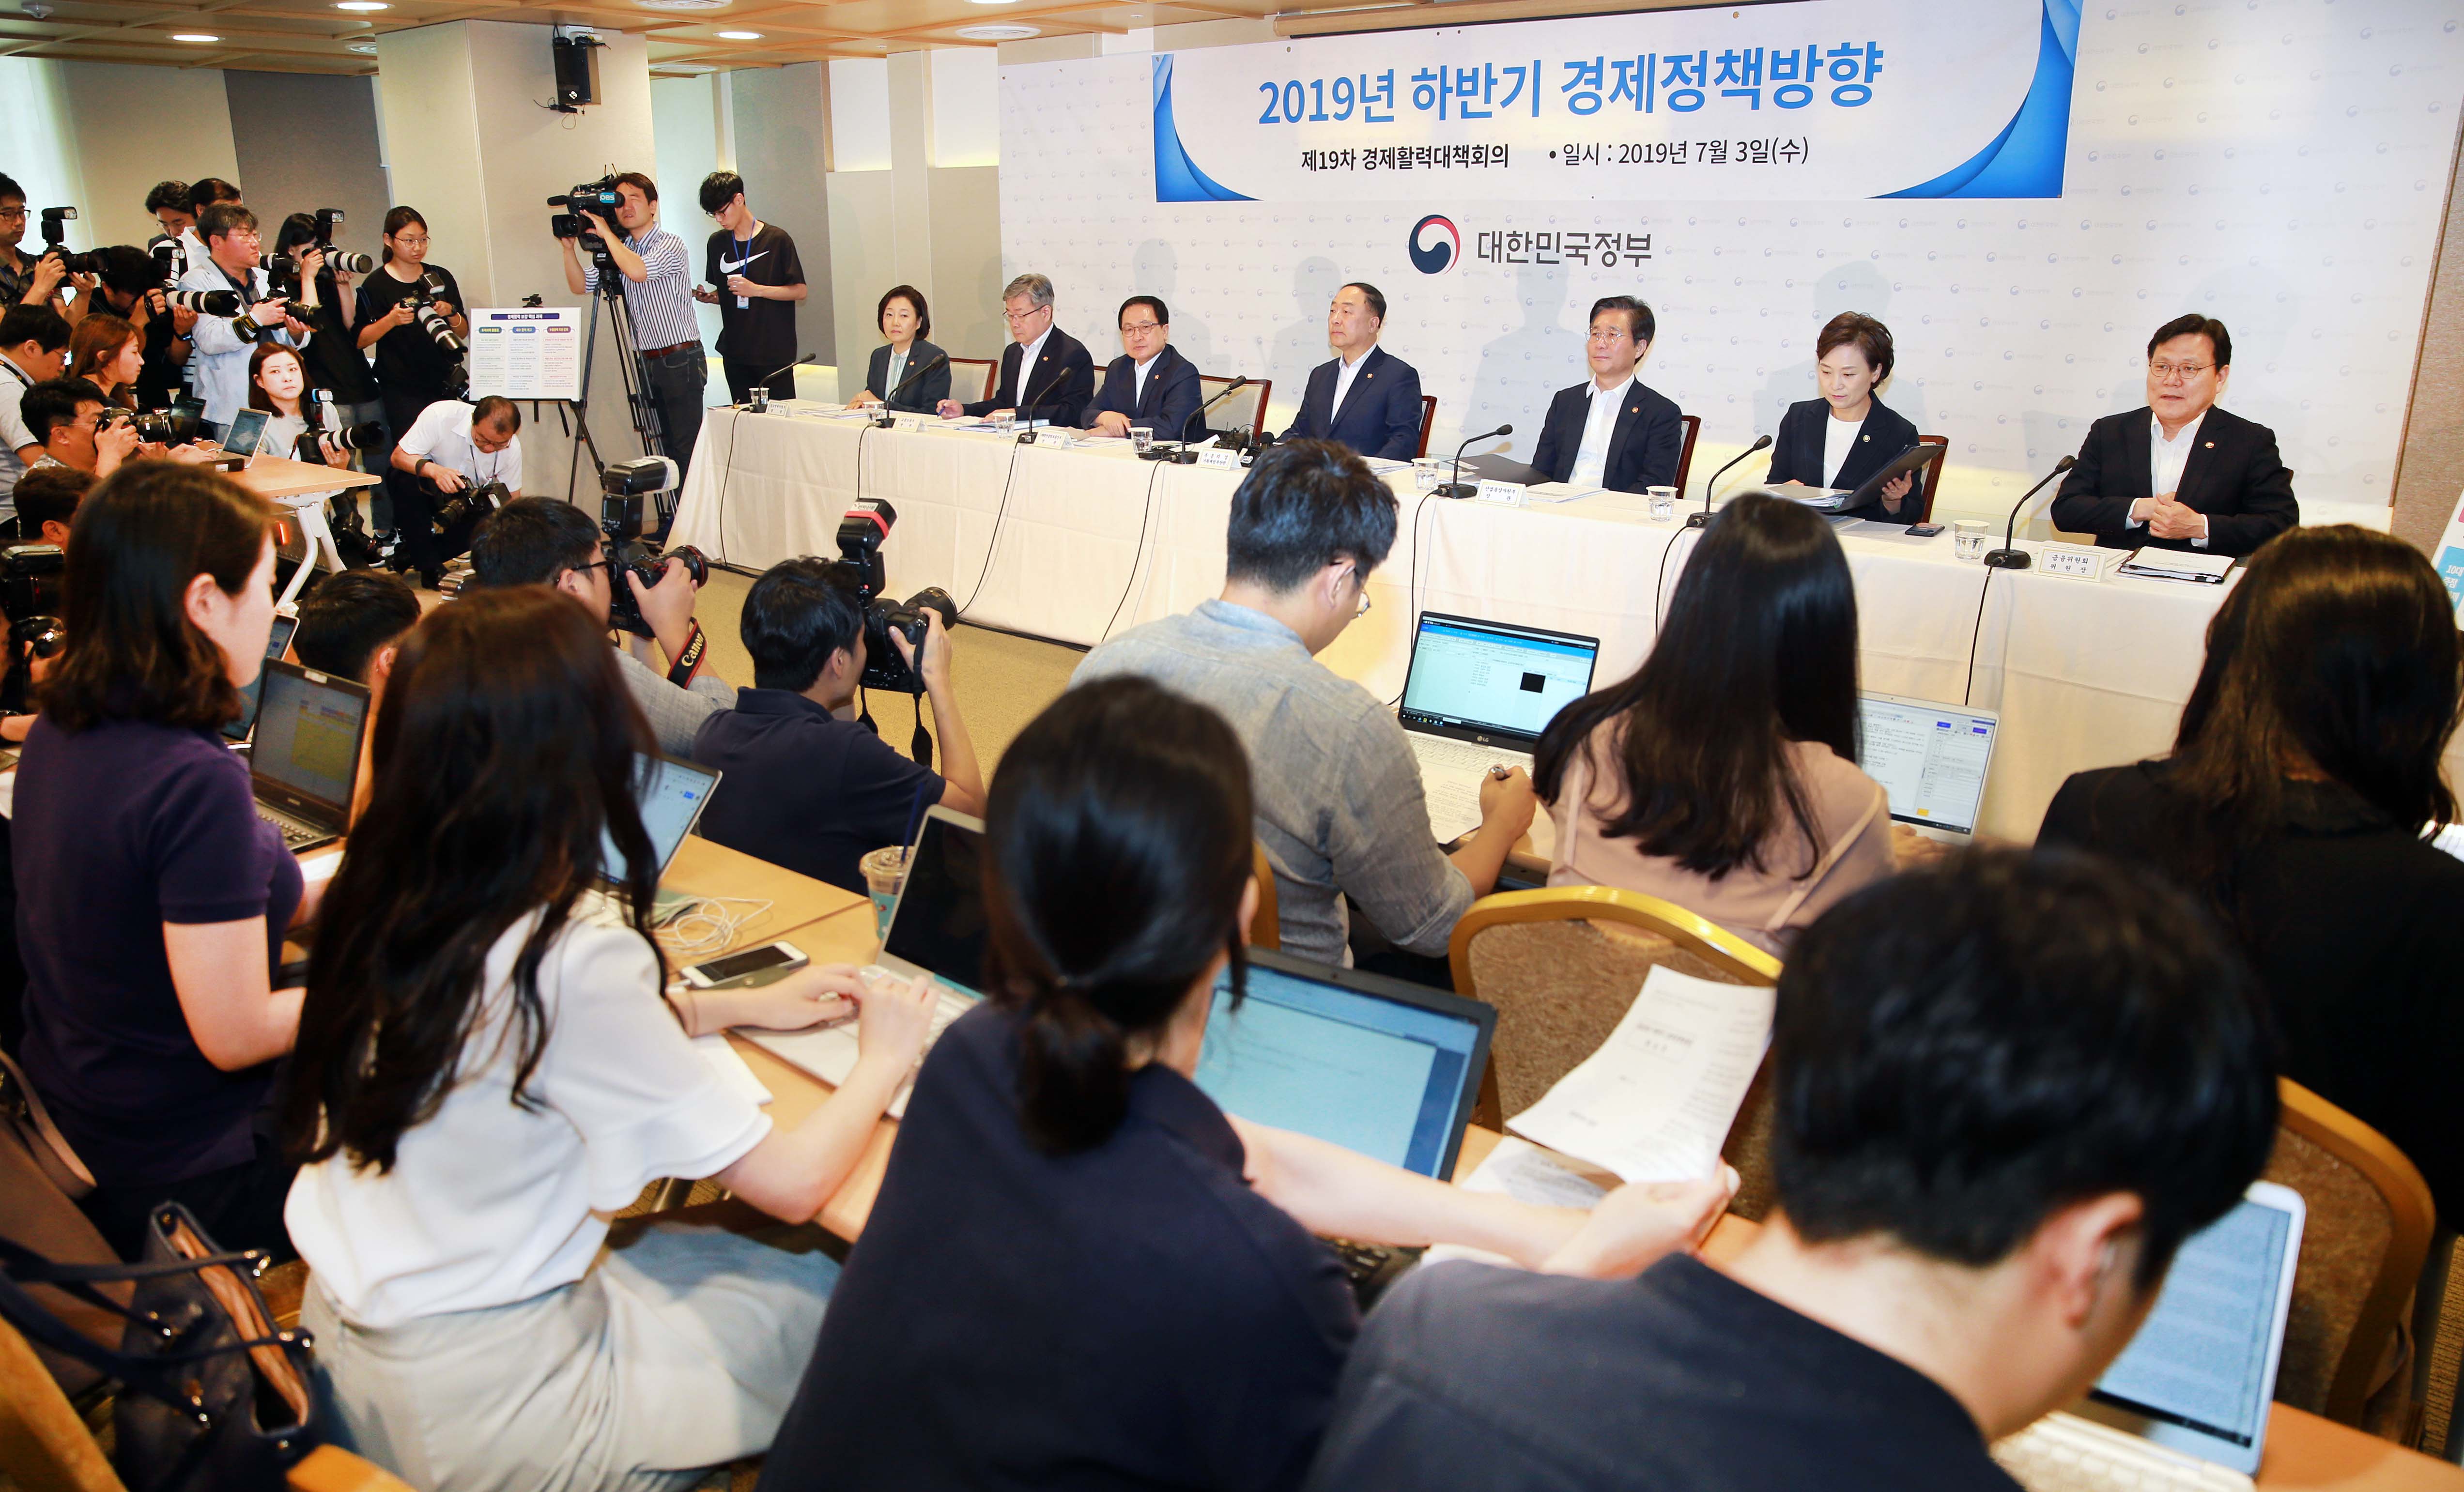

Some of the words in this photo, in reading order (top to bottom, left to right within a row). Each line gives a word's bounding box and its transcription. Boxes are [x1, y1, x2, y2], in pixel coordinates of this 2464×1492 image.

[1259, 69, 1394, 124] 2019년
[1411, 60, 1541, 121] 하반기
[1561, 41, 1884, 115] 경제정책방향
[1301, 148, 1357, 172] 제19차
[1362, 143, 1509, 170] 경제활력대책회의
[1563, 142, 1599, 166] 일시
[1618, 140, 1687, 164] 2019년
[1695, 139, 1727, 164] 7월
[1735, 136, 1808, 165] 3일(수)
[1478, 231, 1652, 268] 대한민국정부
[2051, 554, 2089, 564] 금융위원회
[681, 632, 704, 667] Canon
